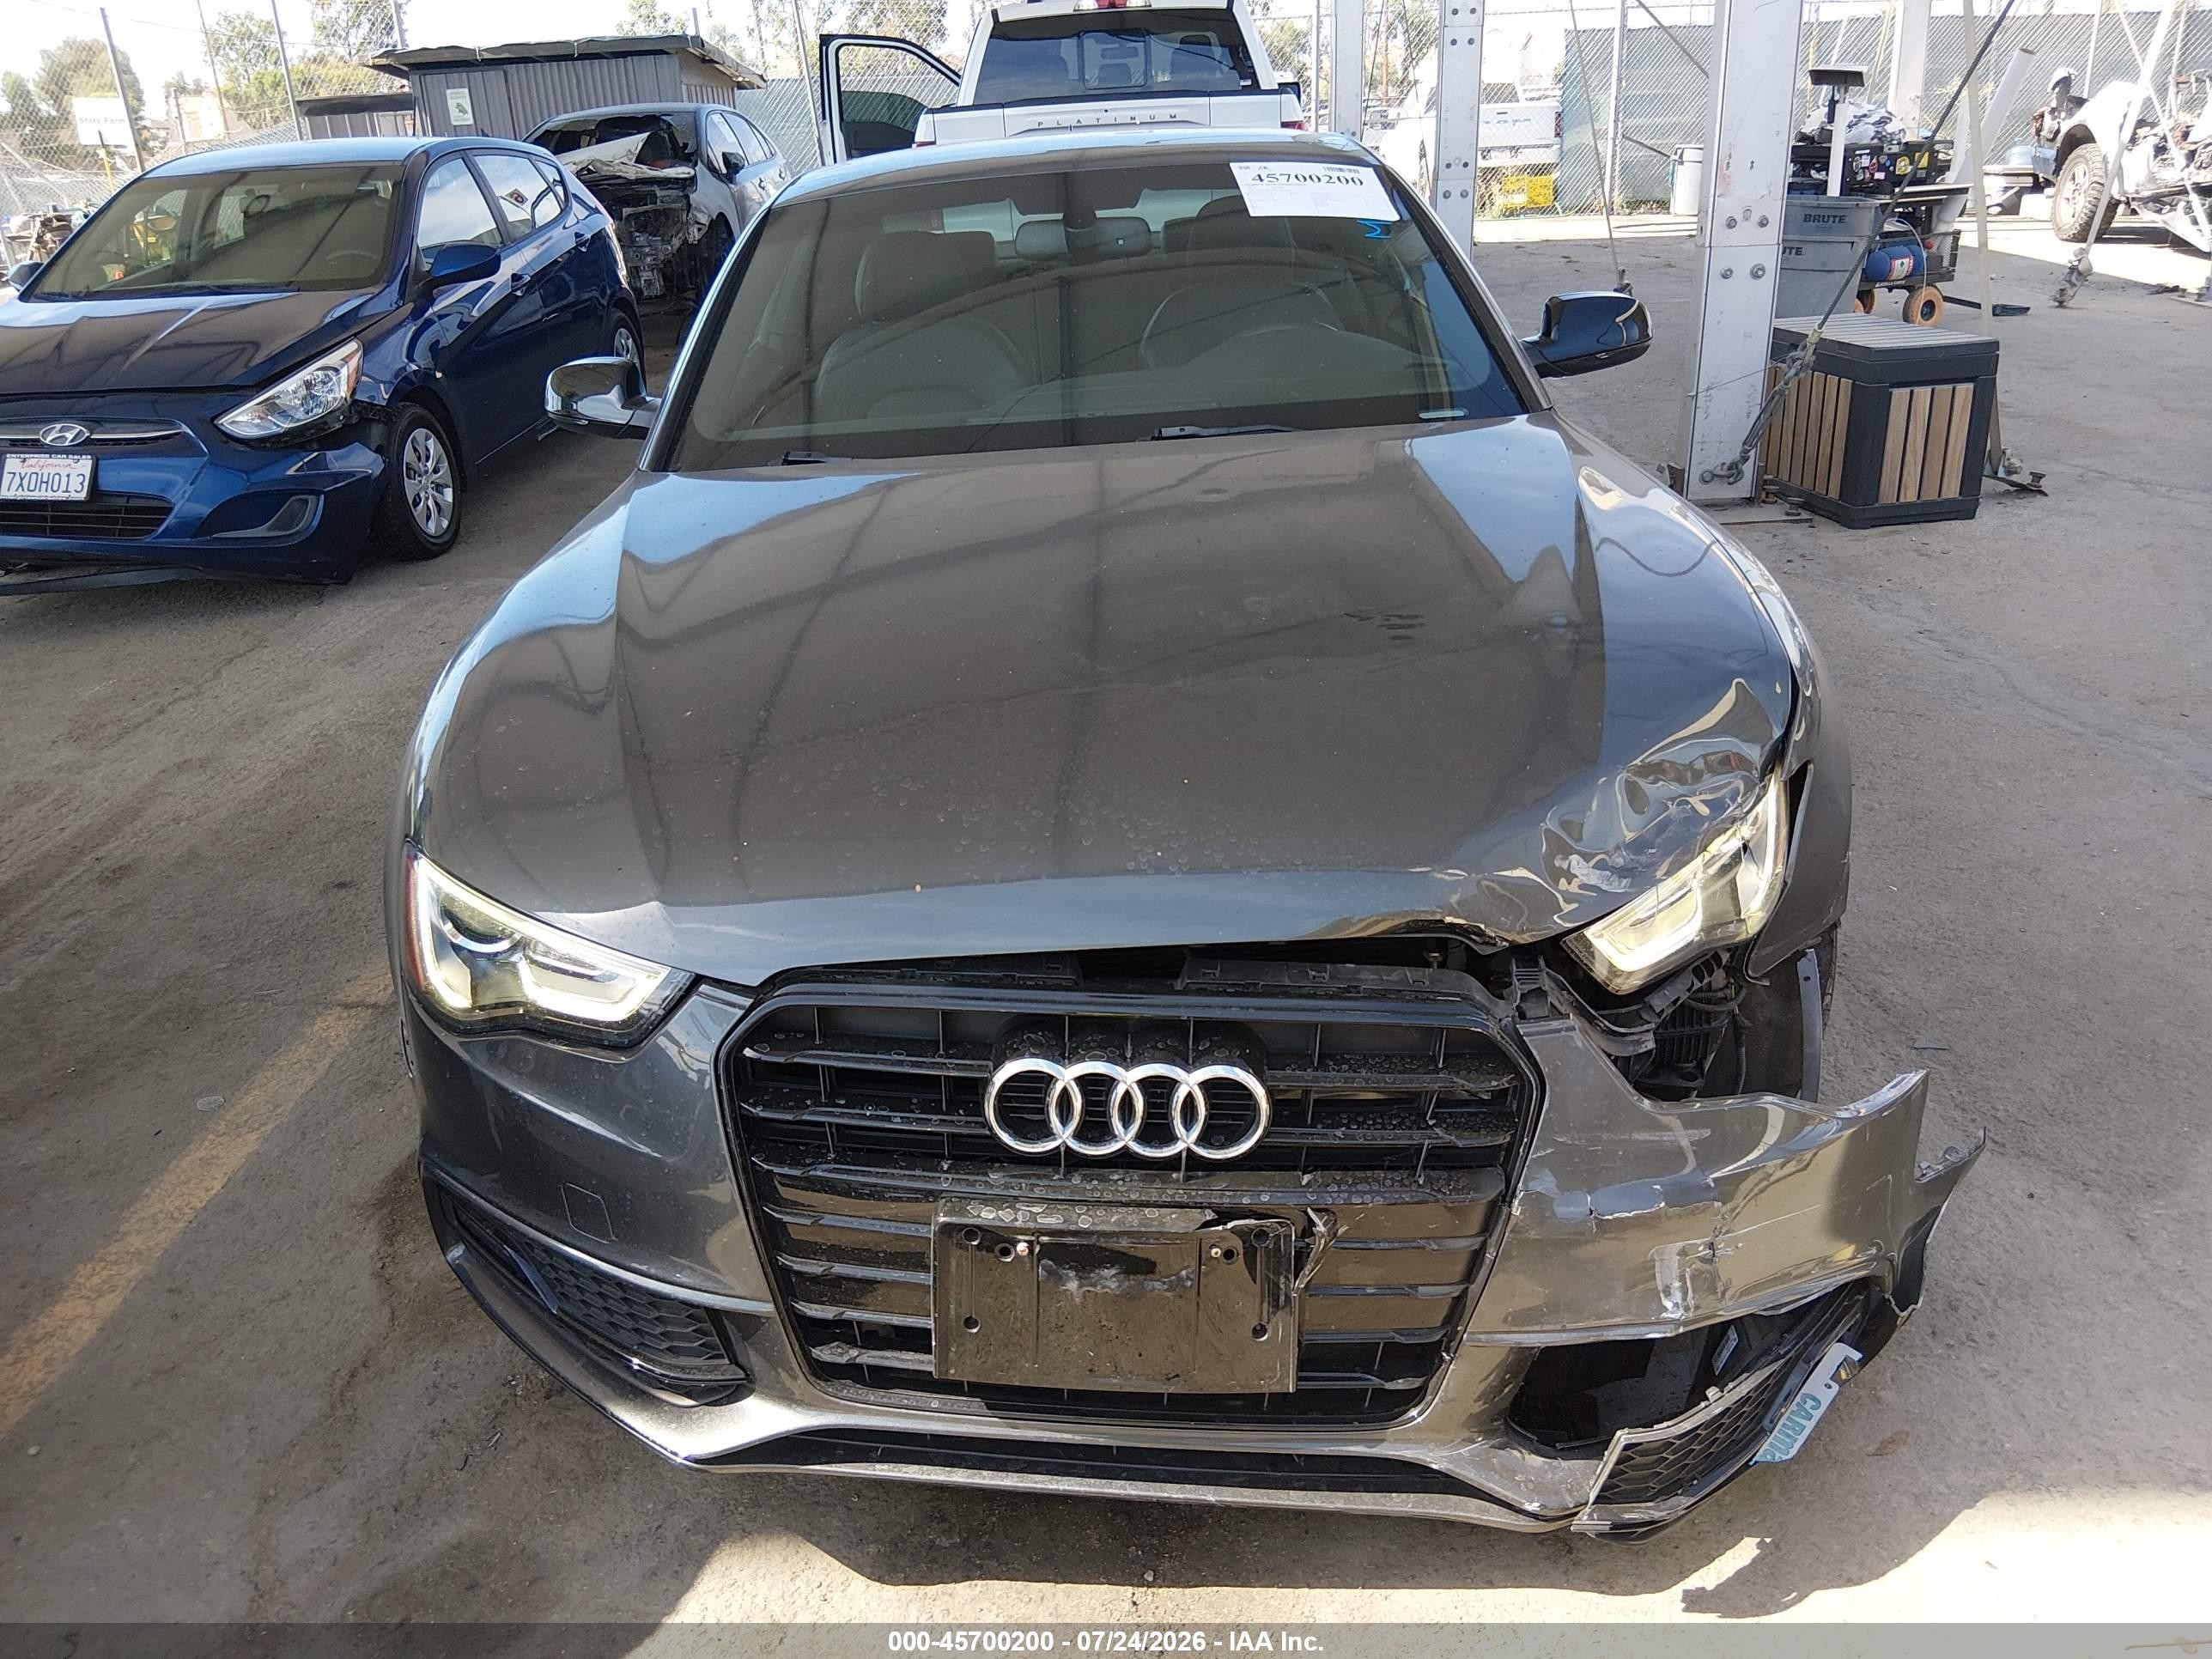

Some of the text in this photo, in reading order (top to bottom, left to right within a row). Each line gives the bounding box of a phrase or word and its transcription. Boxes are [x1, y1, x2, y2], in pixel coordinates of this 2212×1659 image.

[1037, 114, 1177, 128] PLATINUM
[1251, 173, 1364, 186] 45700200
[1803, 213, 1848, 224] BRUTE
